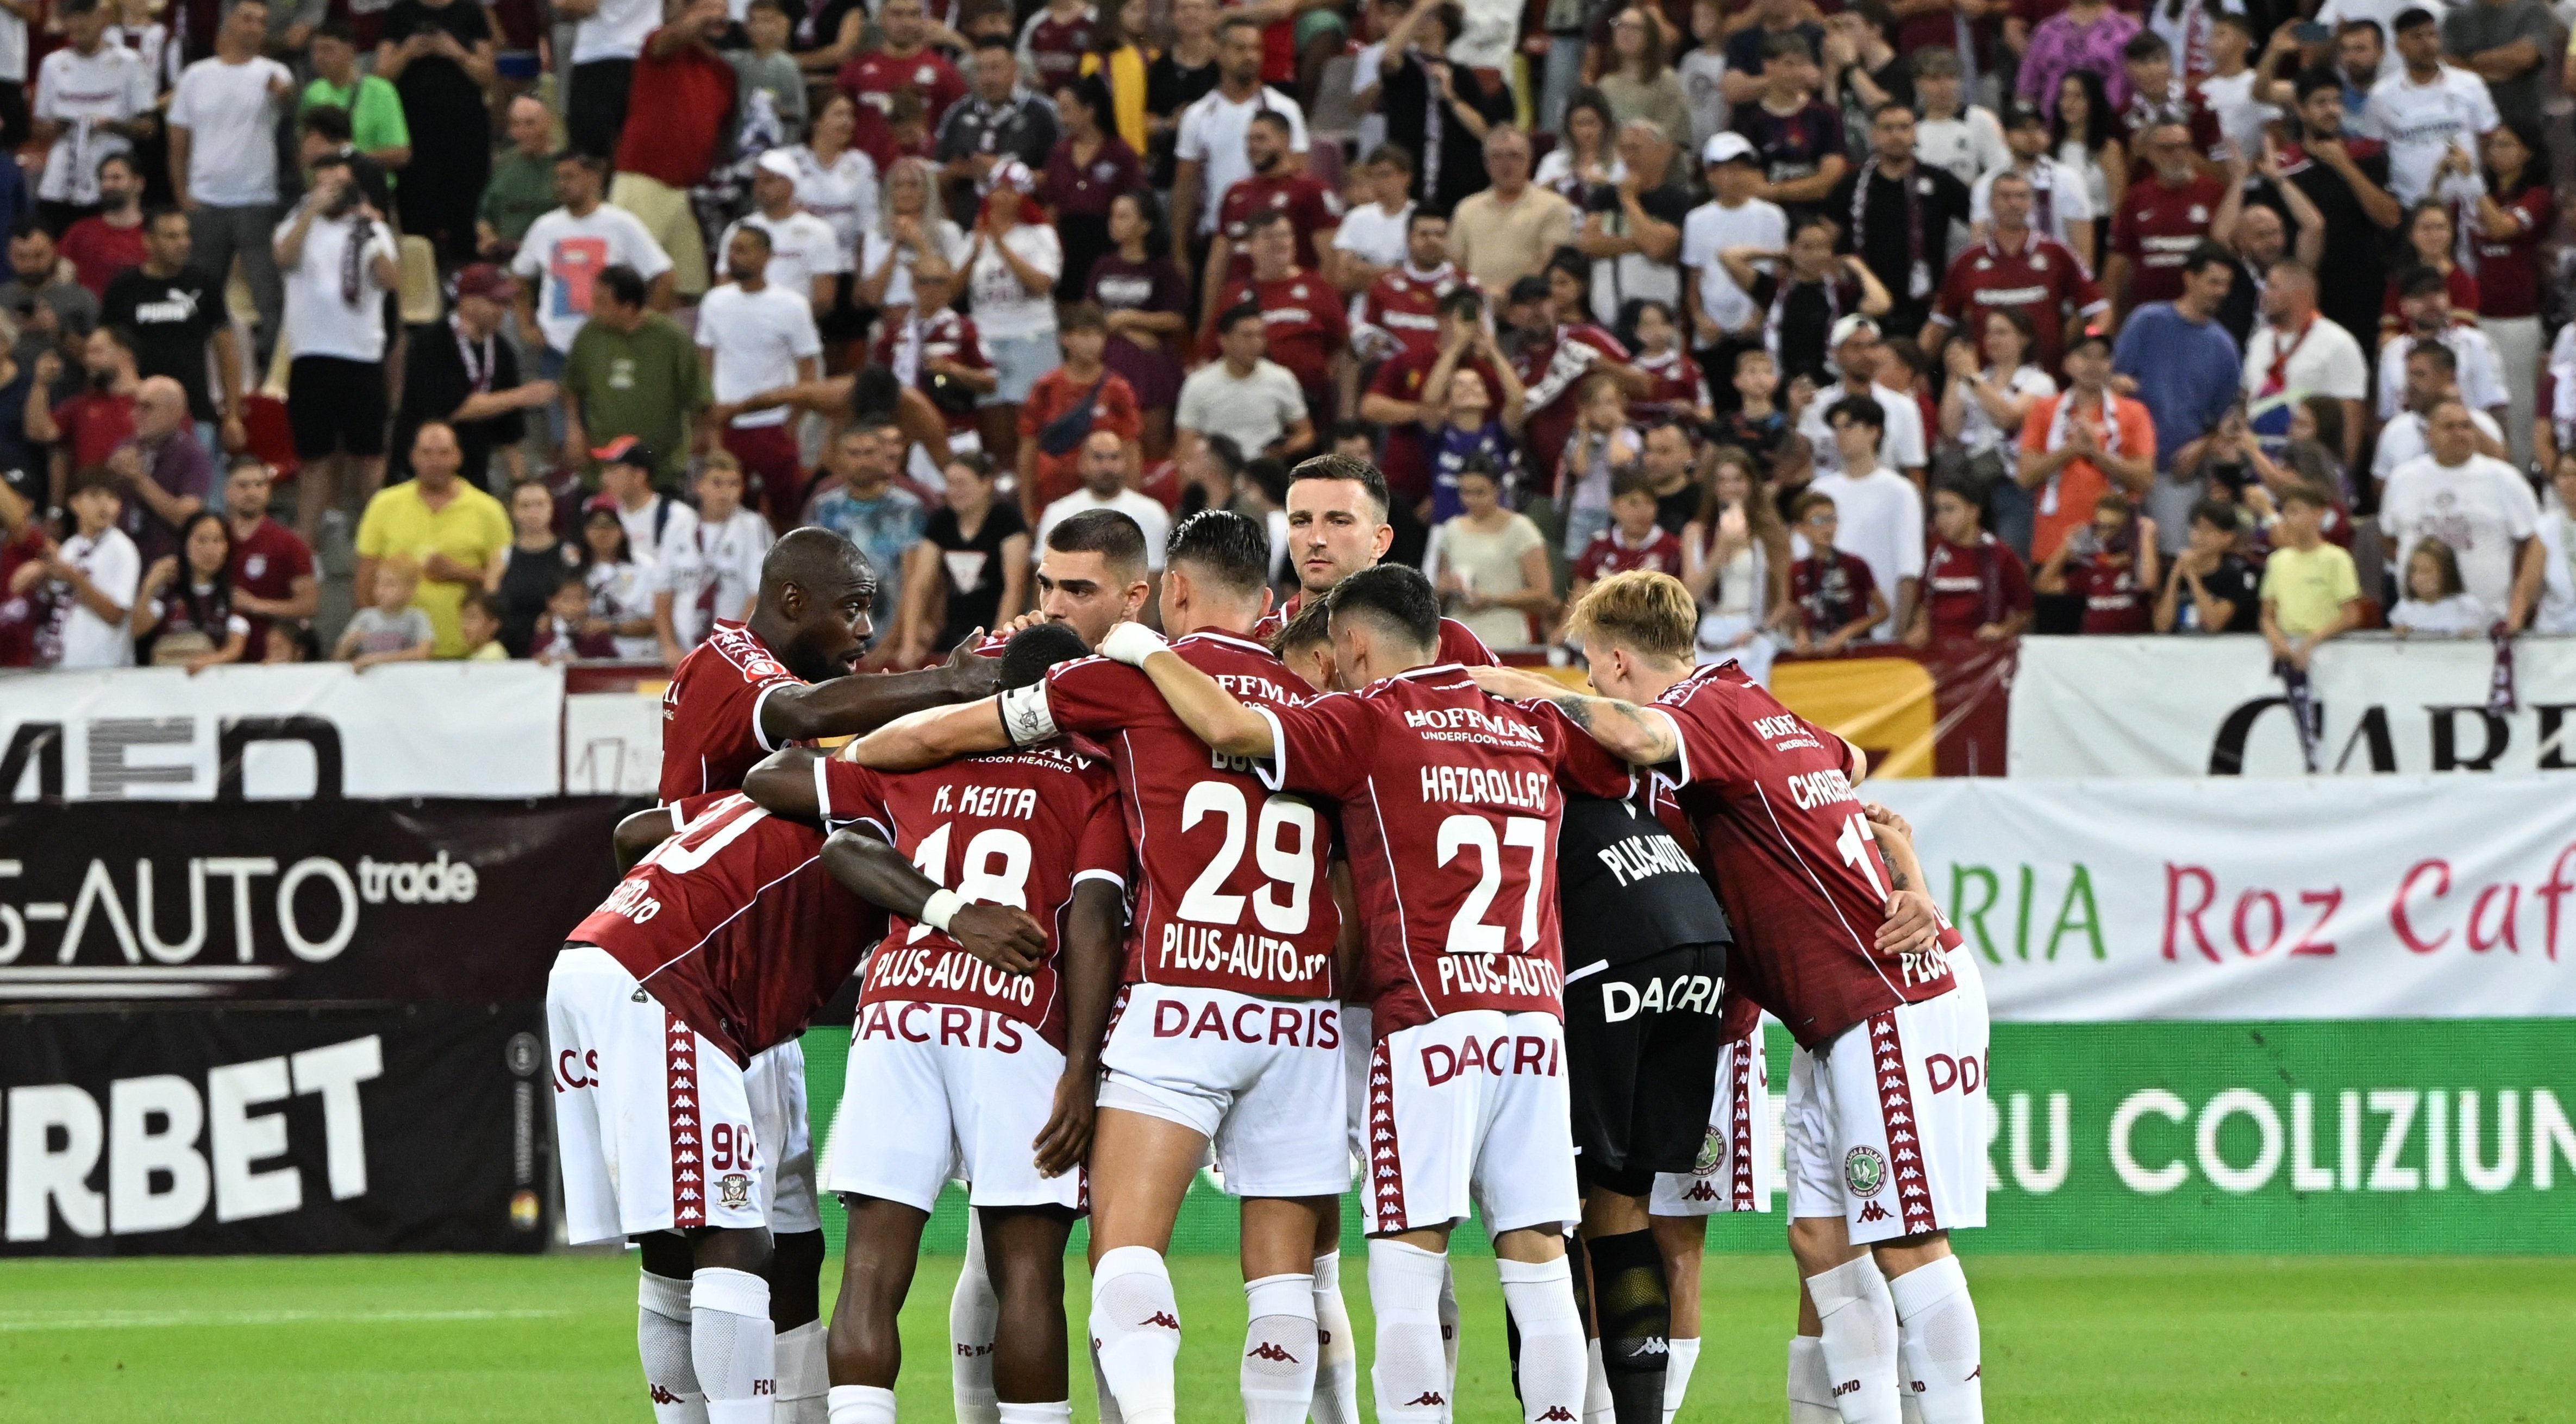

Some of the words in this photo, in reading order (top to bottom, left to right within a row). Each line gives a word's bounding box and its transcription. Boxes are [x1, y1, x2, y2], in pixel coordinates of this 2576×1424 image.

[1404, 708, 1544, 743] HOFFMAN
[1421, 731, 1498, 745] UNDERFLOOR
[1017, 756, 1073, 773] HEATING
[1421, 765, 1548, 811] HAZROLLAJ
[932, 785, 953, 815] K.
[959, 785, 1037, 820] KEITA
[356, 850, 480, 904] trade
[1176, 781, 1315, 934] 29
[911, 821, 1032, 945] 18
[1436, 814, 1546, 953] 27
[2161, 862, 2343, 963] Roz
[1159, 923, 1326, 981] PLUS-AUTO.ro
[1602, 974, 1724, 1023] DACRI
[1153, 1000, 1340, 1050] DACRIS
[1421, 1035, 1565, 1087] DACRI
[712, 1123, 754, 1170] 90
[1710, 1128, 1722, 1144] VLAD
[1866, 1148, 1882, 1163] VLAD
[753, 1379, 768, 1395] FC
[1833, 1379, 1861, 1398] RAPID
